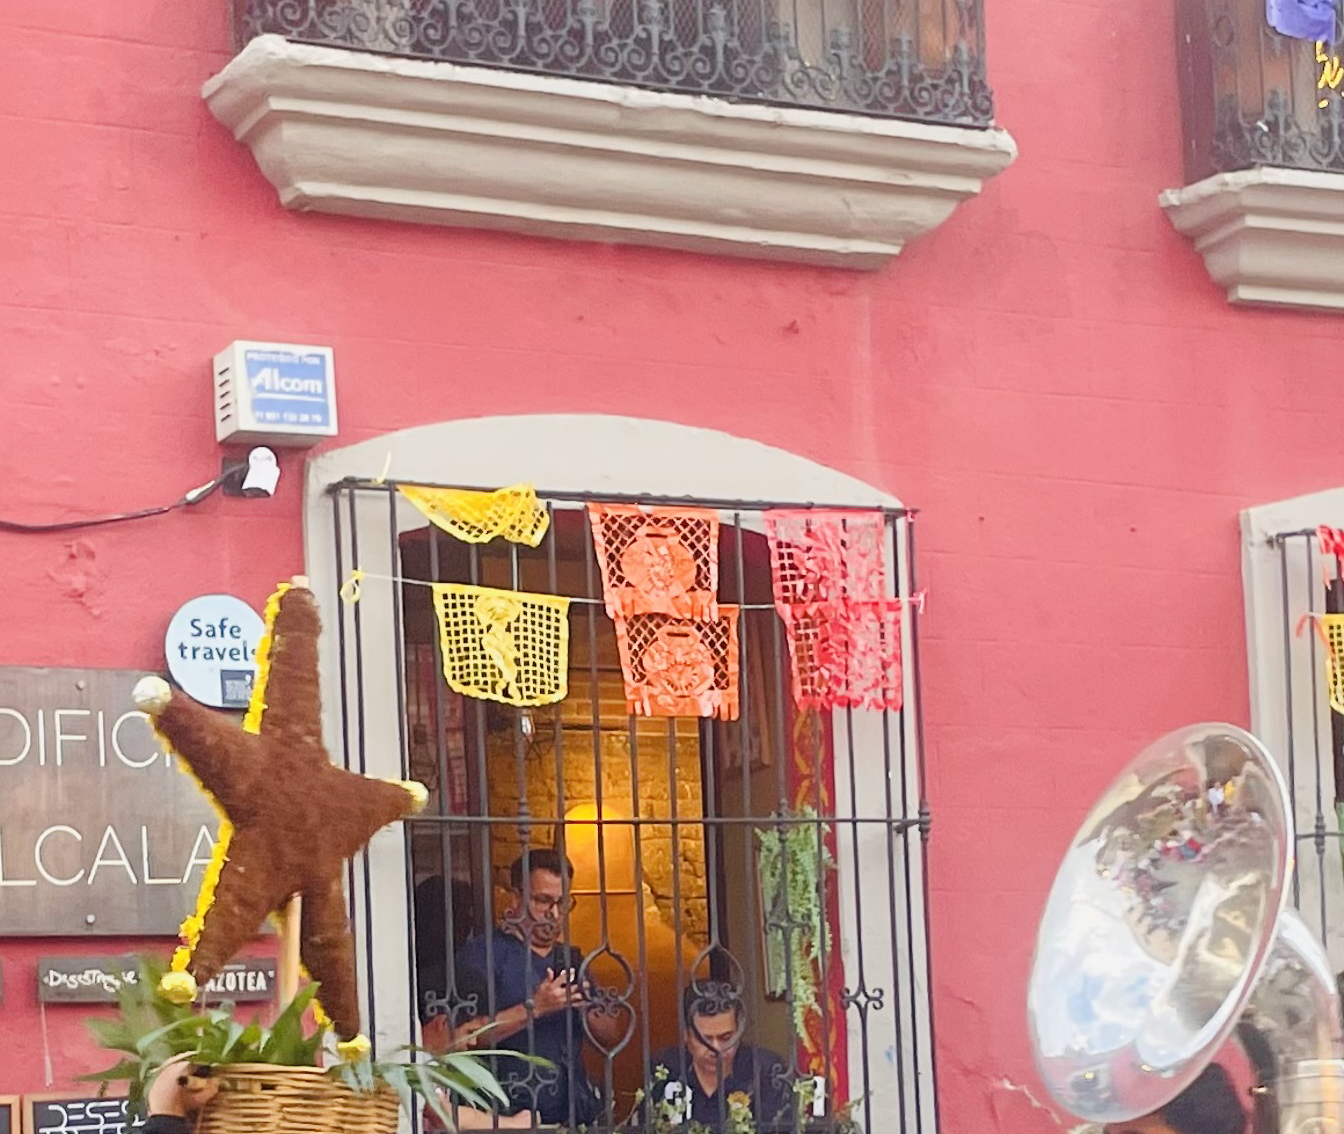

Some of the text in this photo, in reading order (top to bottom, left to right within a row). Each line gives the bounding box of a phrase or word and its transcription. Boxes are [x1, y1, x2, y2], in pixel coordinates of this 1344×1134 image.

[250, 367, 324, 395] Alcom
[189, 616, 243, 640] Safe
[177, 639, 257, 663] travel
